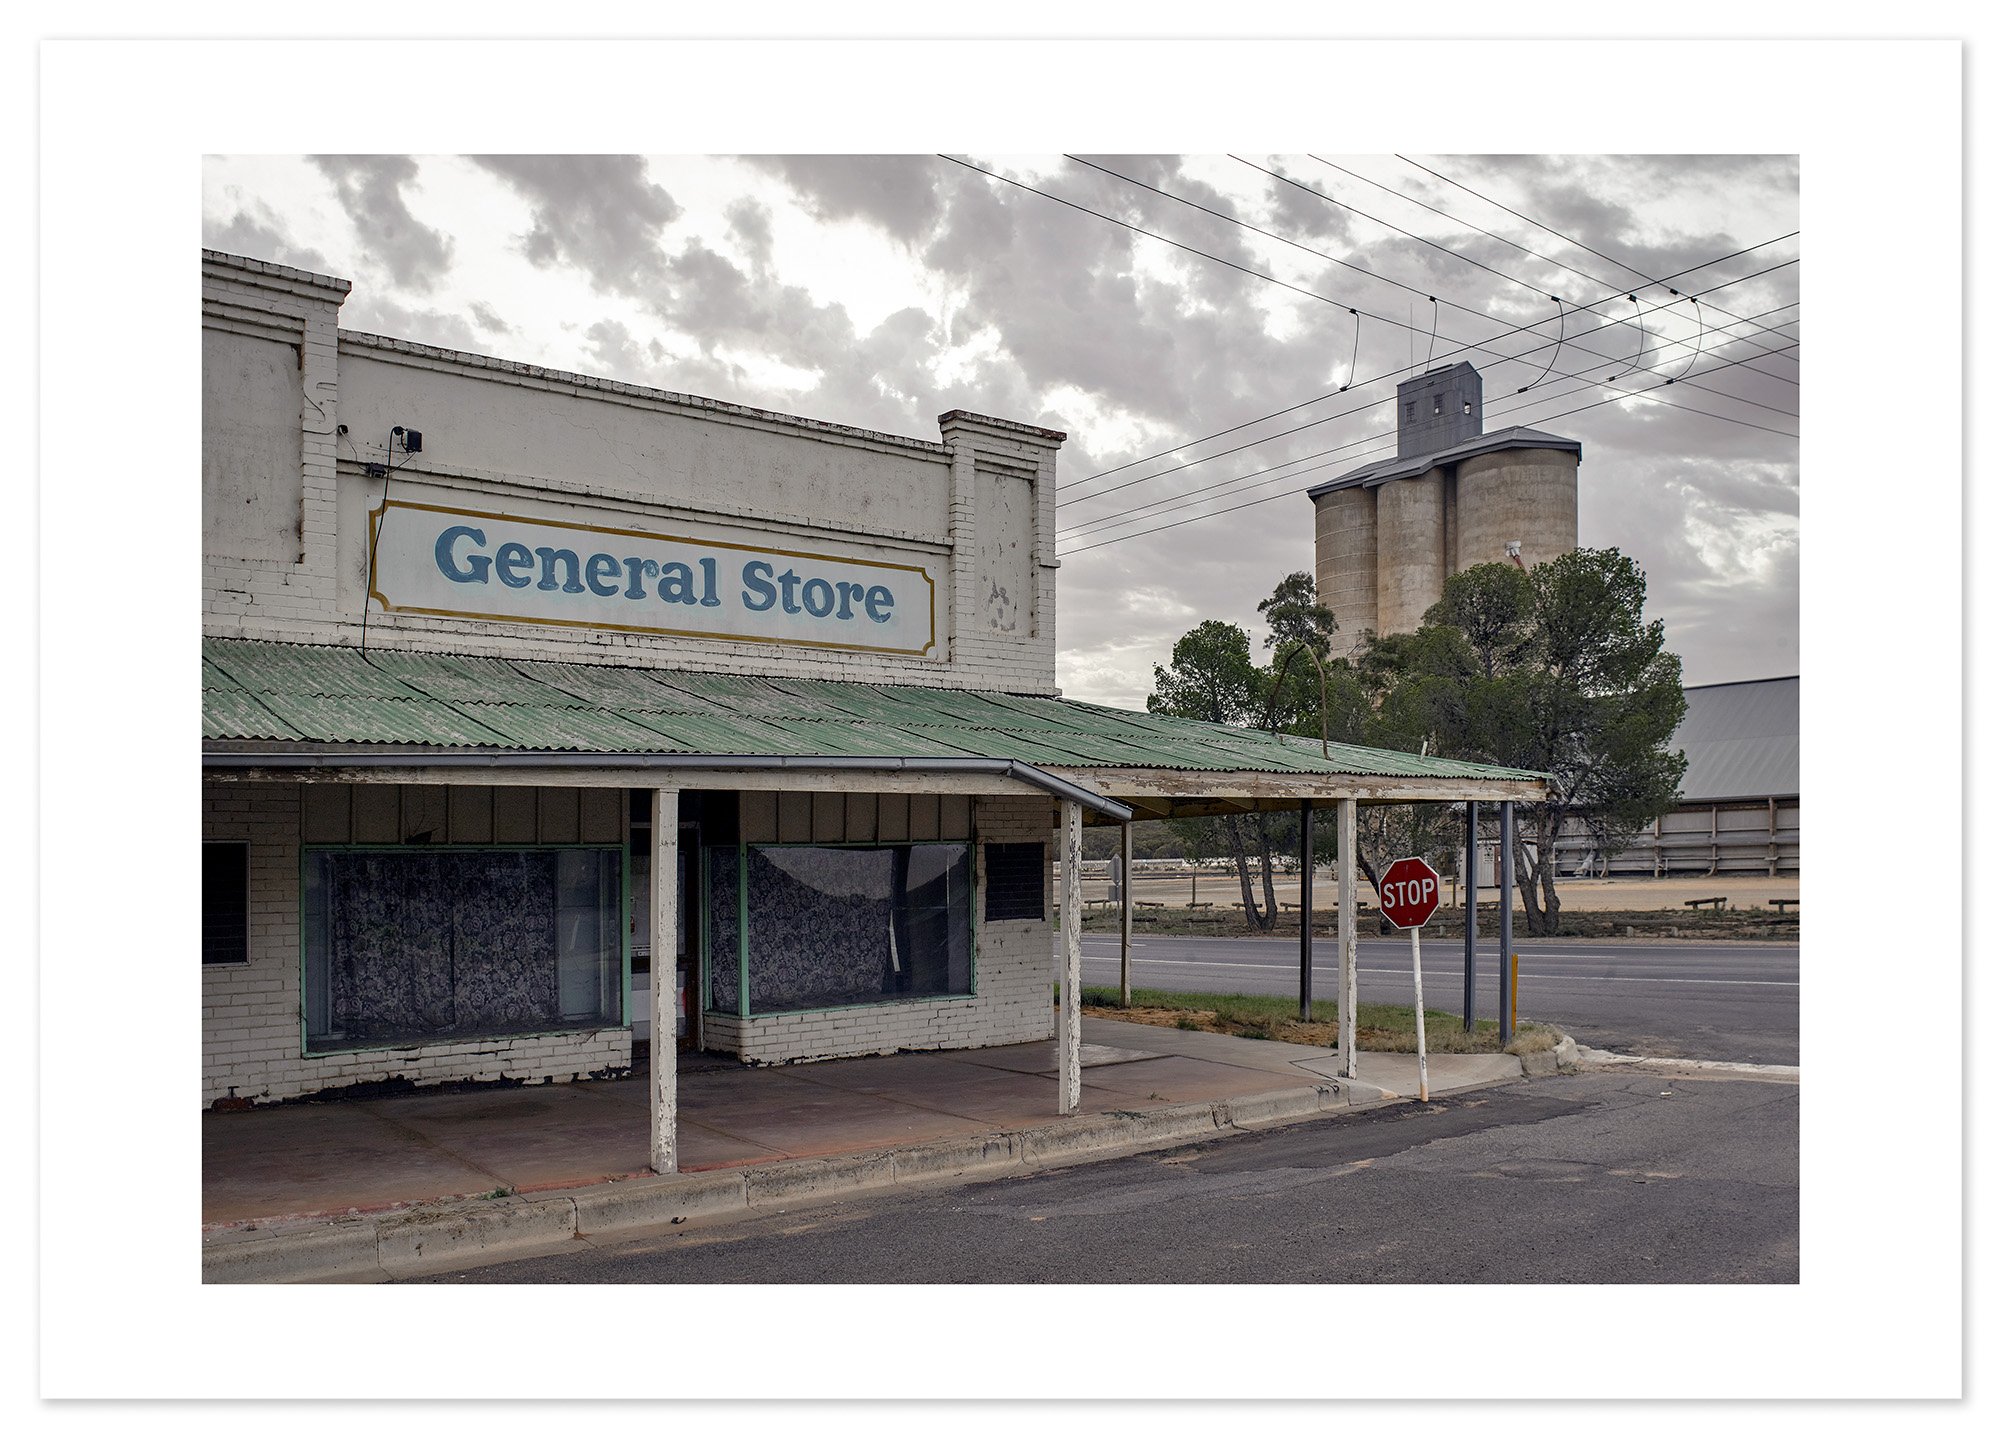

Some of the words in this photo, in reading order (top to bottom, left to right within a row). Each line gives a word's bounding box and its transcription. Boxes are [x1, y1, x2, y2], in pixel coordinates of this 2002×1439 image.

[434, 525, 721, 607] General
[741, 560, 895, 624] Store
[1383, 878, 1435, 908] STOP
